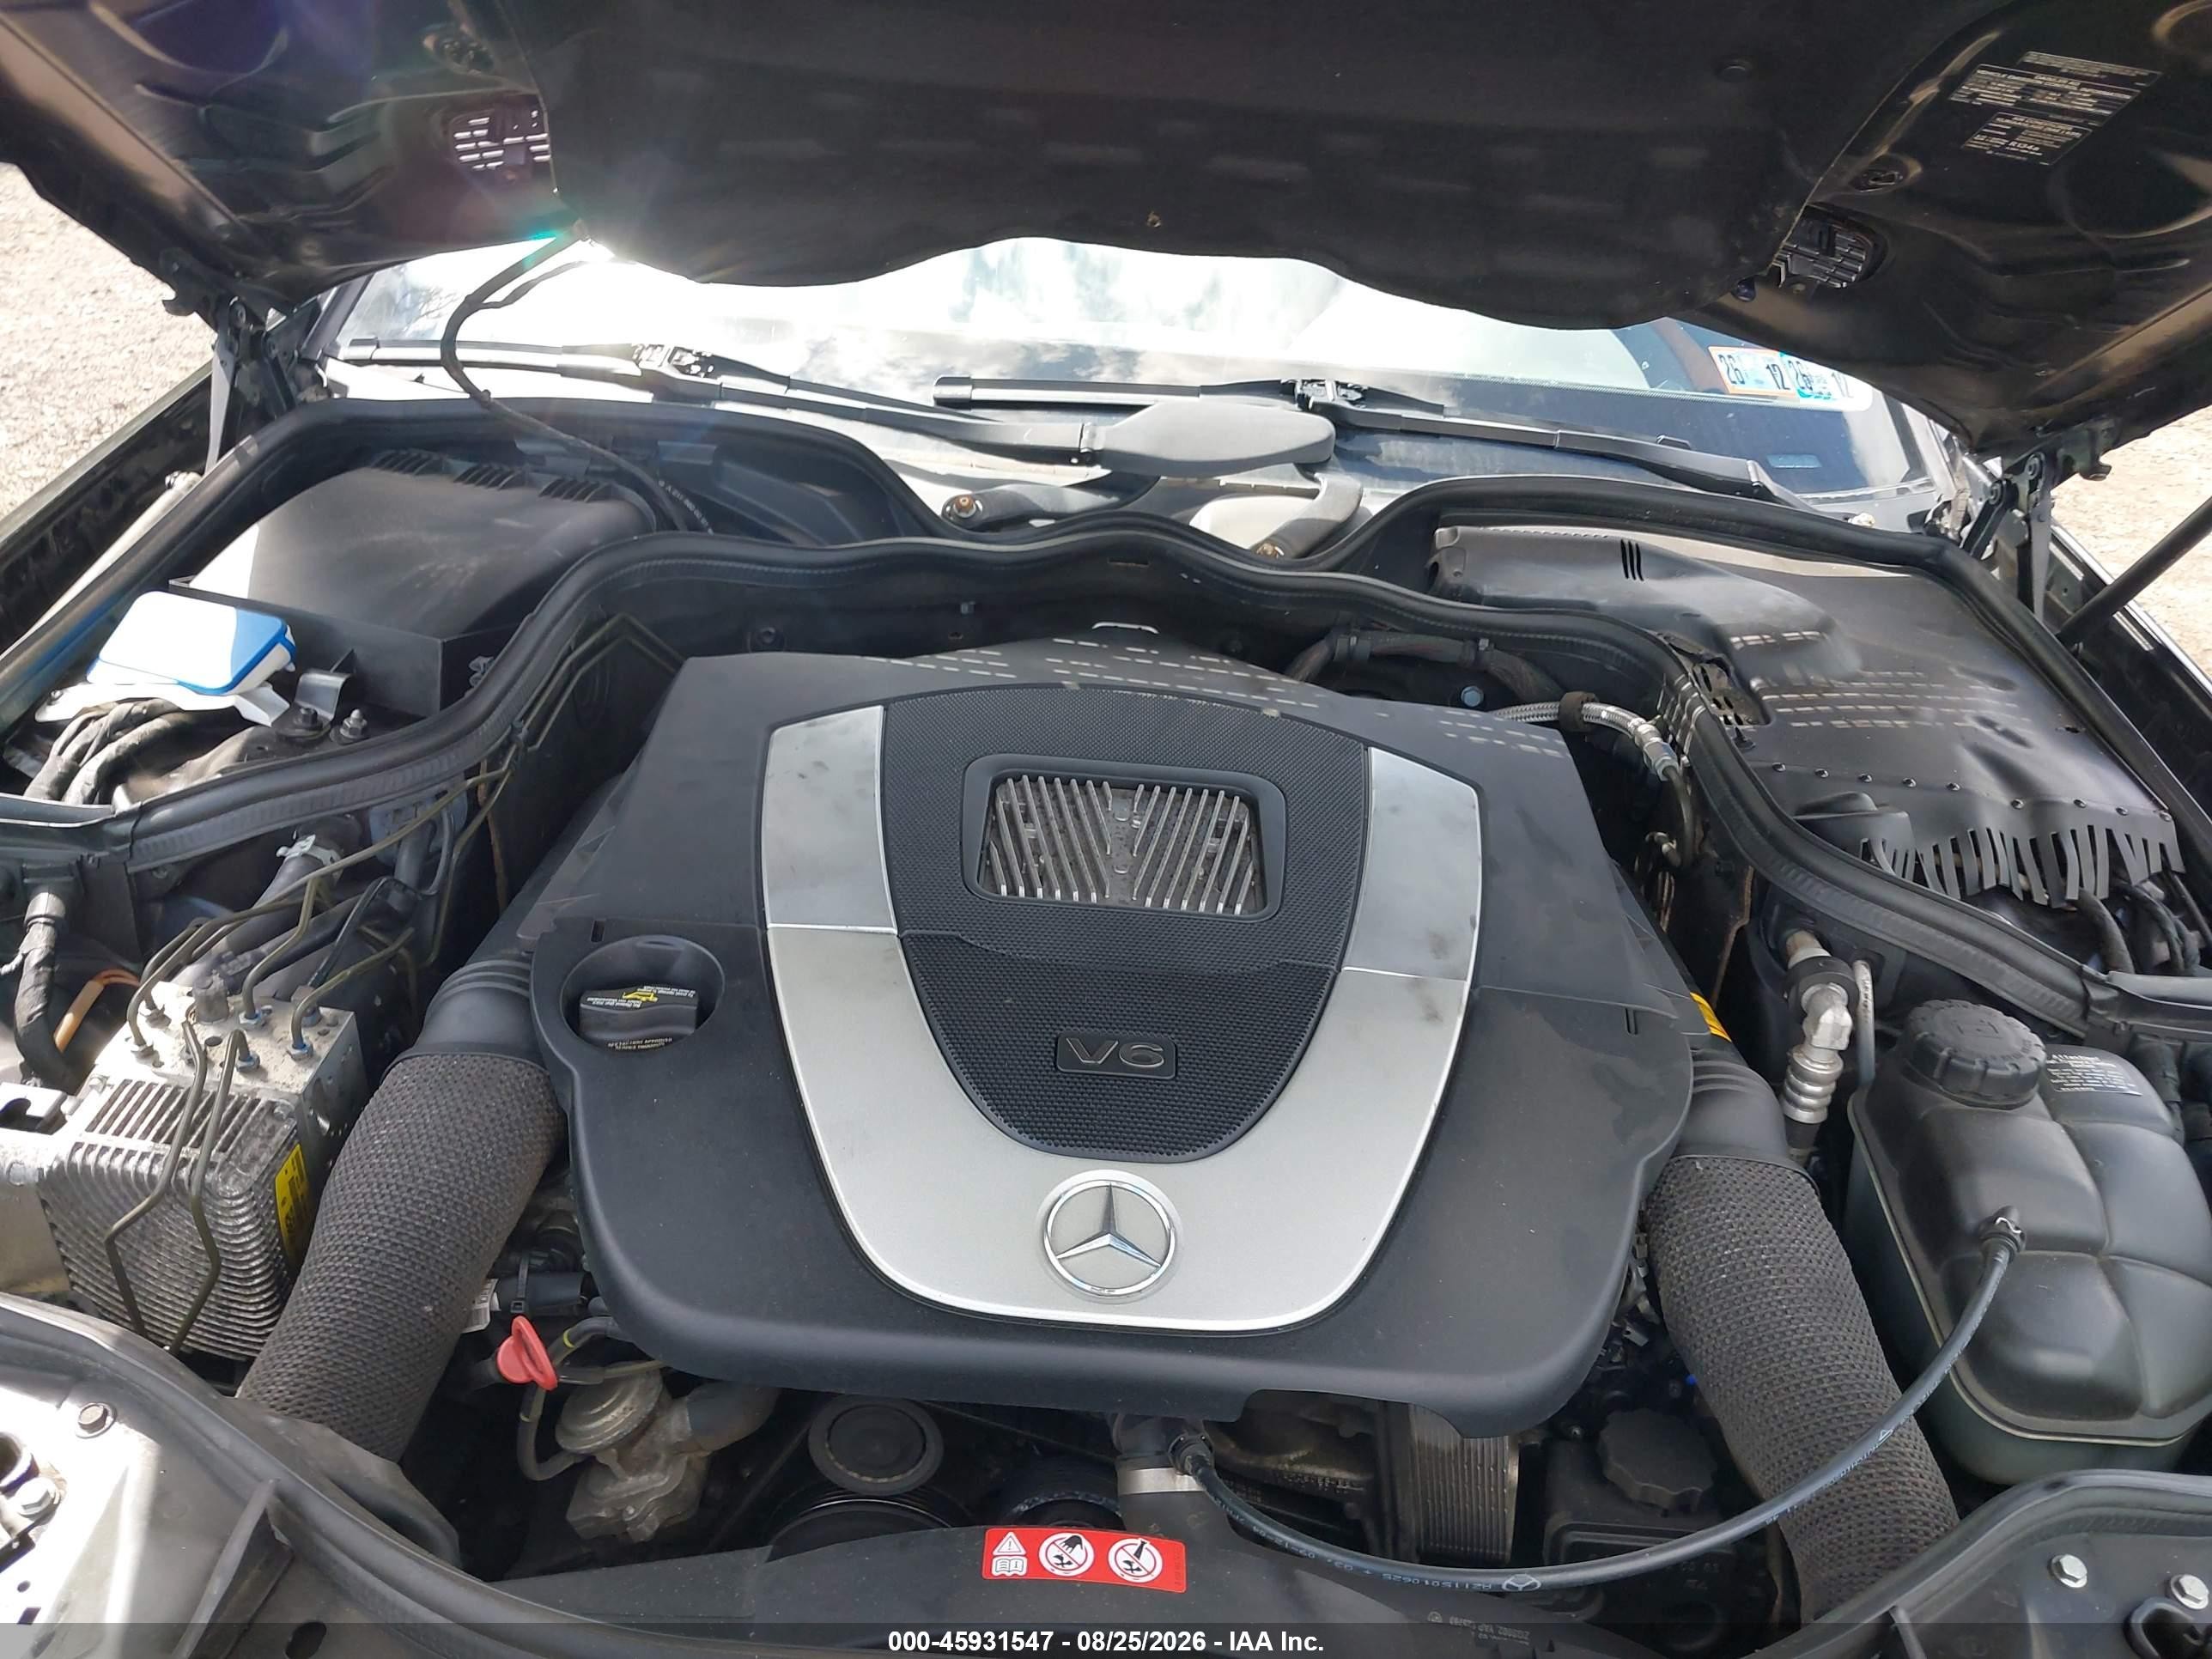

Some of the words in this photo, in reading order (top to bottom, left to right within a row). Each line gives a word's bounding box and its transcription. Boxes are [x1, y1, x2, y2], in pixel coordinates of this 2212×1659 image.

[1718, 355, 1746, 385] 26
[1766, 363, 1790, 390] 12
[1066, 1037, 1164, 1068] V6
